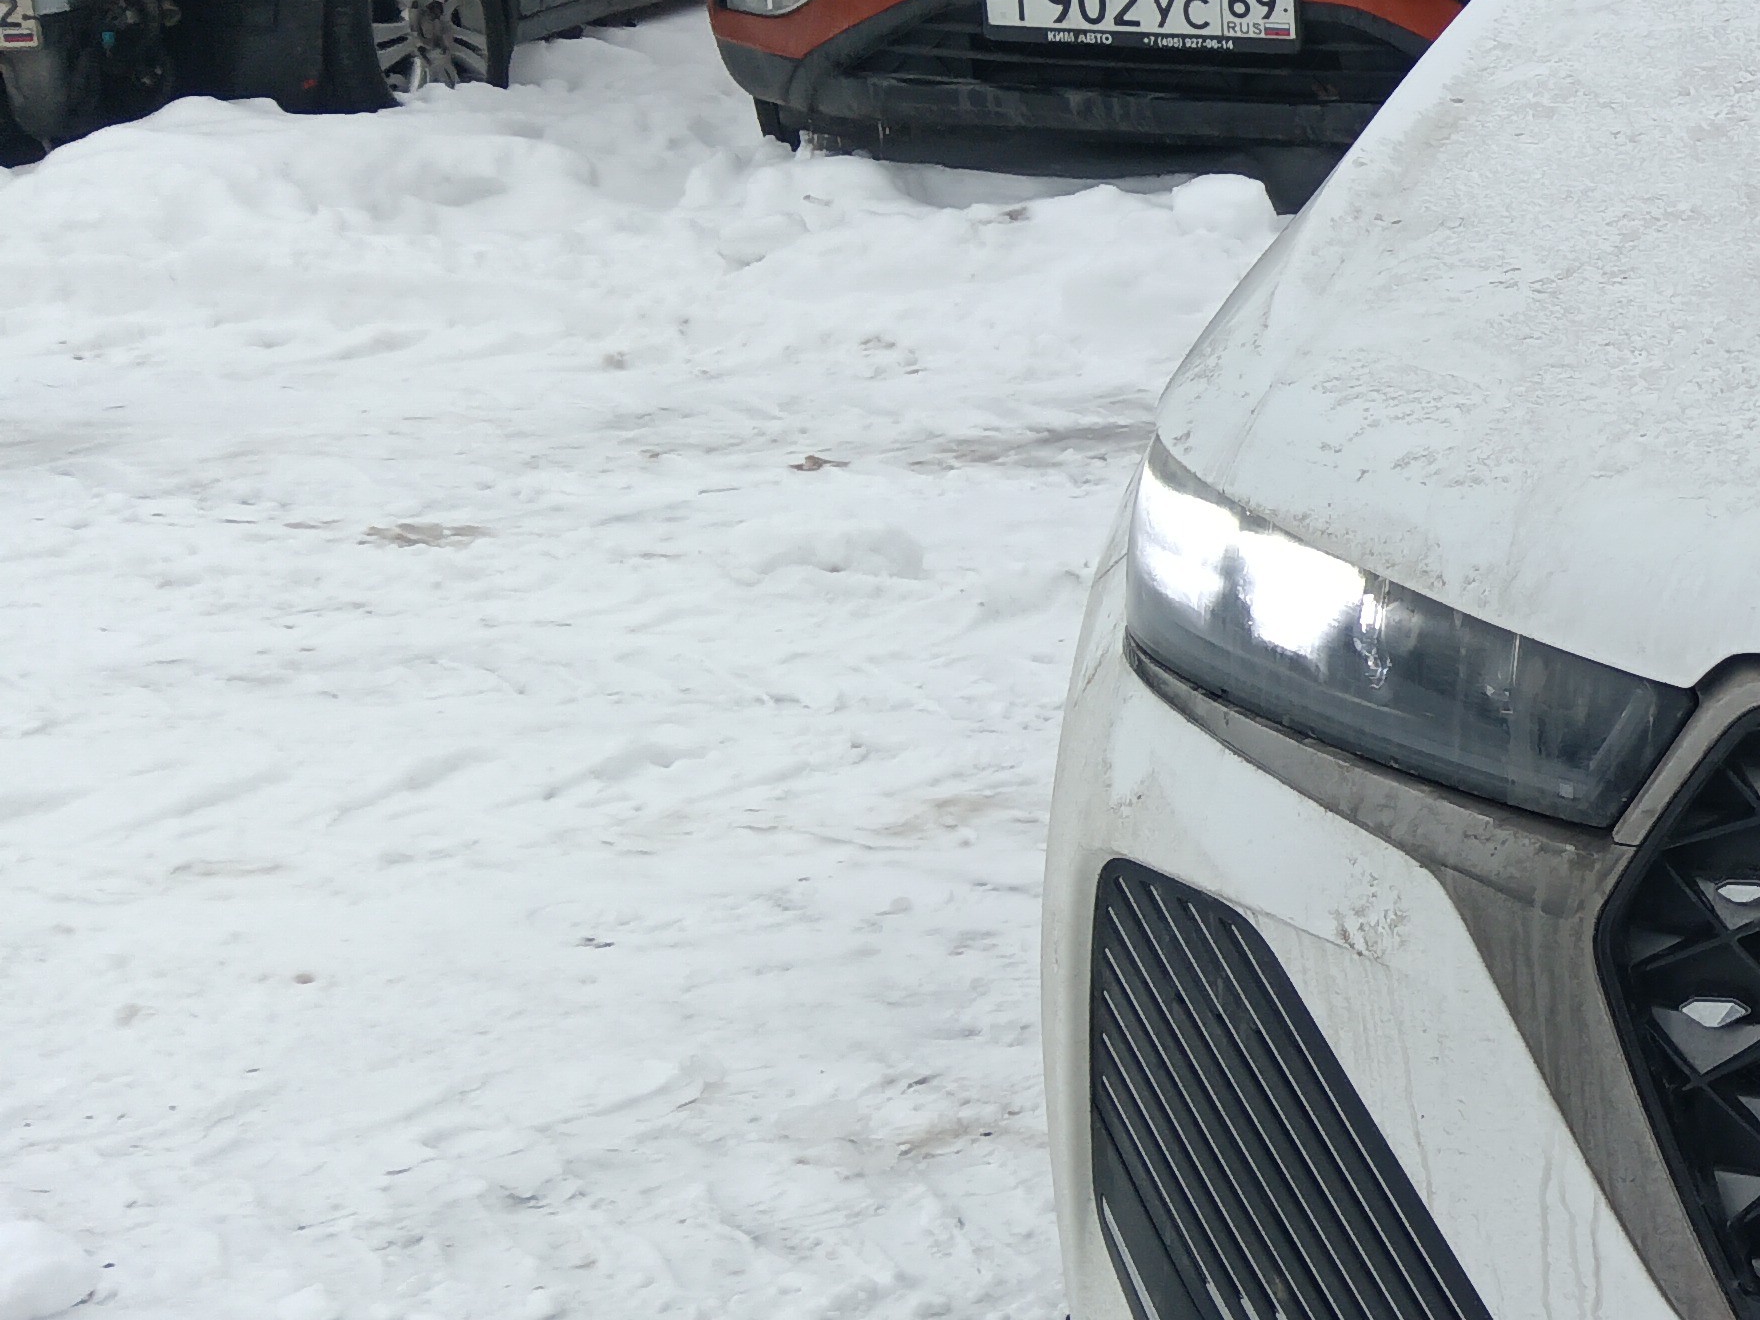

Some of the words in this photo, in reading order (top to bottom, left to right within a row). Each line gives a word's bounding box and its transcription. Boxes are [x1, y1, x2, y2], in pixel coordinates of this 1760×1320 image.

[1227, 21, 1262, 35] RUS
[1048, 31, 1075, 43] КИМ
[1077, 33, 1112, 45] АВТО
[1143, 35, 1155, 46] +7
